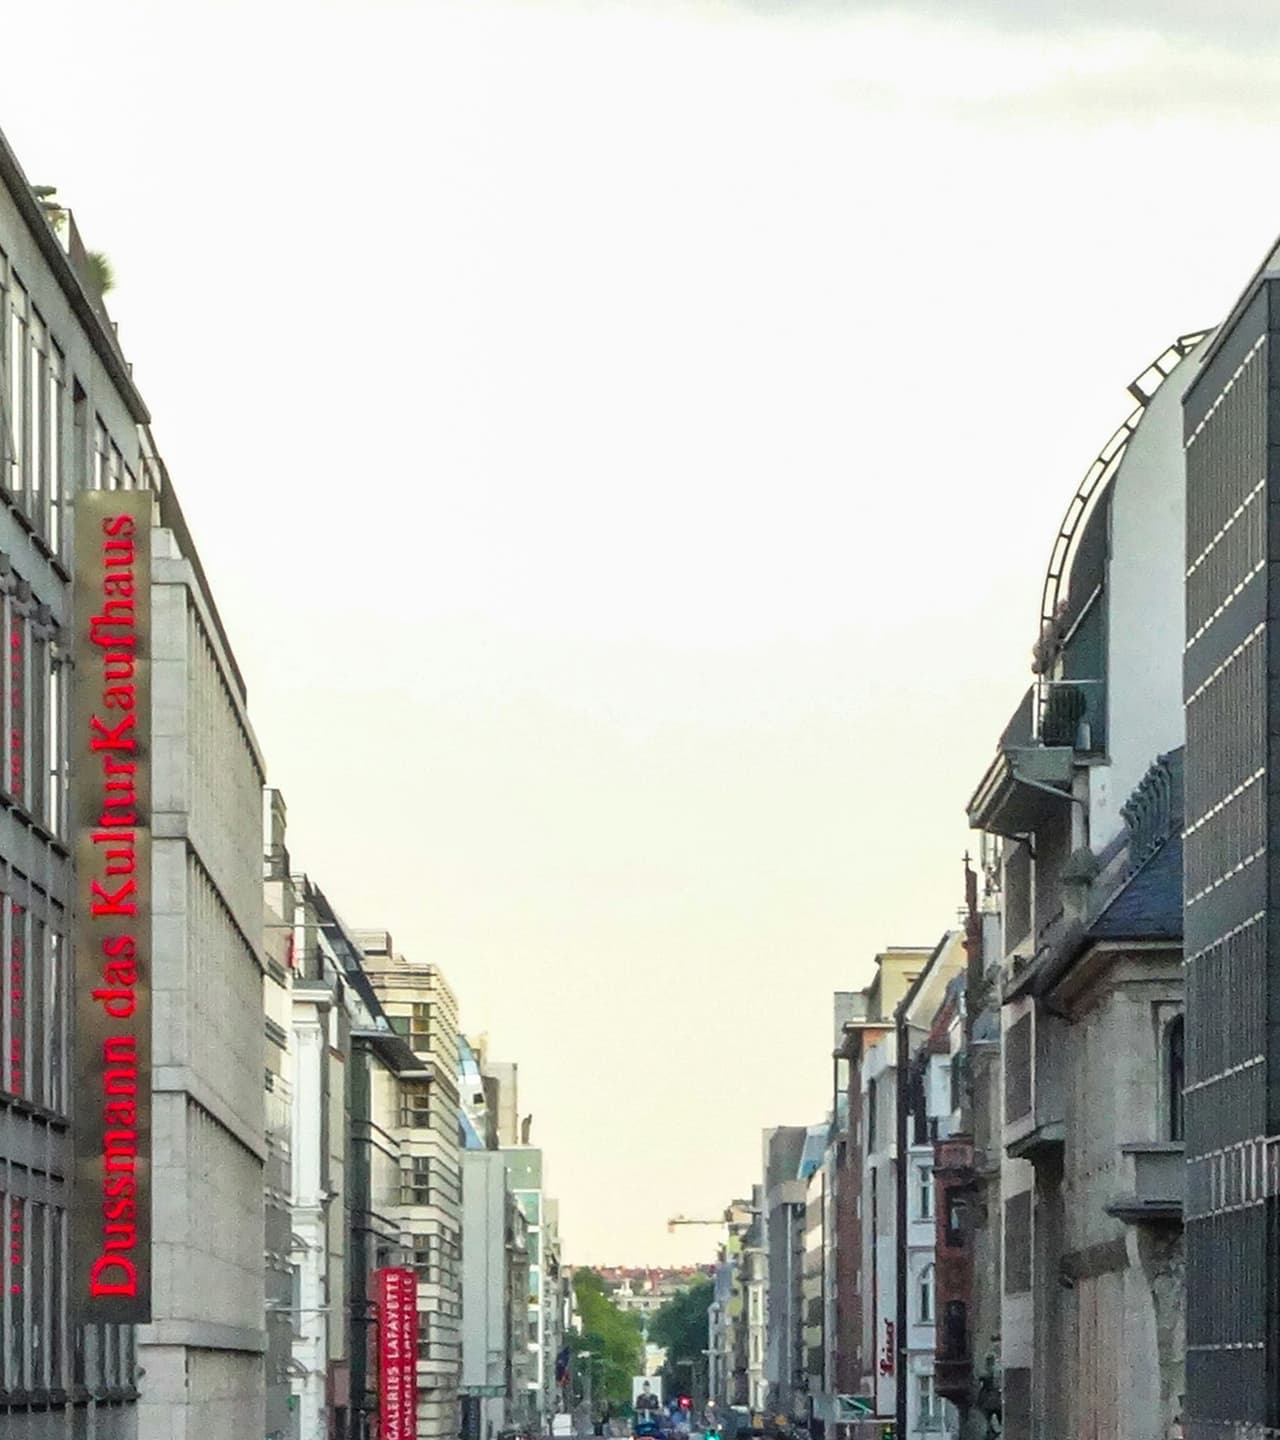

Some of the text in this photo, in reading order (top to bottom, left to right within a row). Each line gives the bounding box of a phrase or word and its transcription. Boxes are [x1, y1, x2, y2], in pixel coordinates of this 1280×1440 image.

[89, 515, 137, 1301] Dussmann das KulturKaufhaus
[386, 1273, 400, 1358] LAFAYETTE
